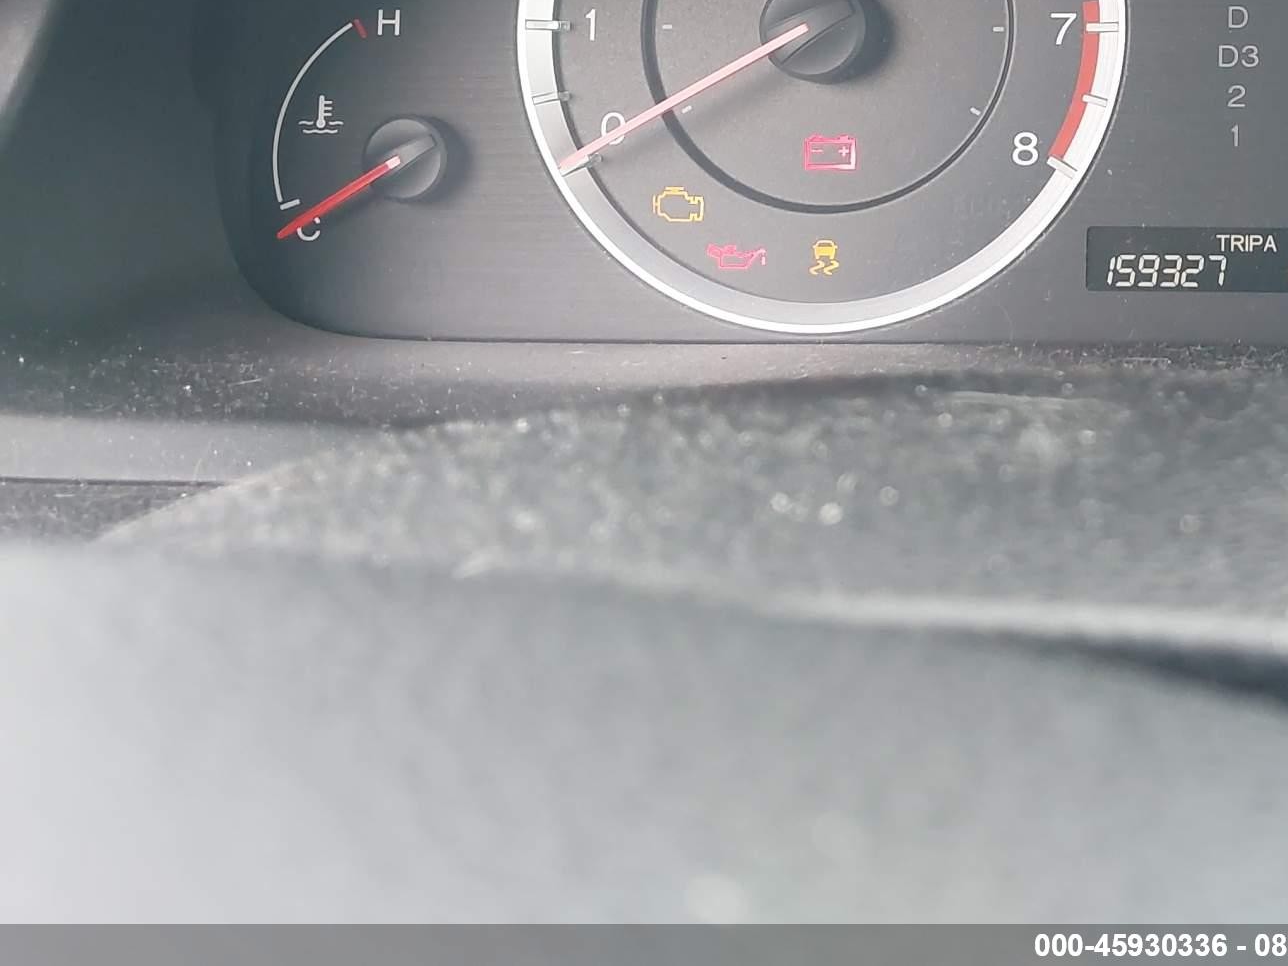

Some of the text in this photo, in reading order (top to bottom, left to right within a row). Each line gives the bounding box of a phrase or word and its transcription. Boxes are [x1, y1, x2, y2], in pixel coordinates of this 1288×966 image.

[378, 10, 400, 35] H
[585, 9, 596, 40] 1
[1051, 13, 1076, 44] 7
[1229, 7, 1248, 28] D
[1219, 46, 1258, 67] D3
[1228, 86, 1245, 107] 2
[601, 112, 626, 145] 0
[1231, 125, 1239, 146] 1
[1013, 132, 1038, 165] 8
[1107, 254, 1226, 288] 159327
